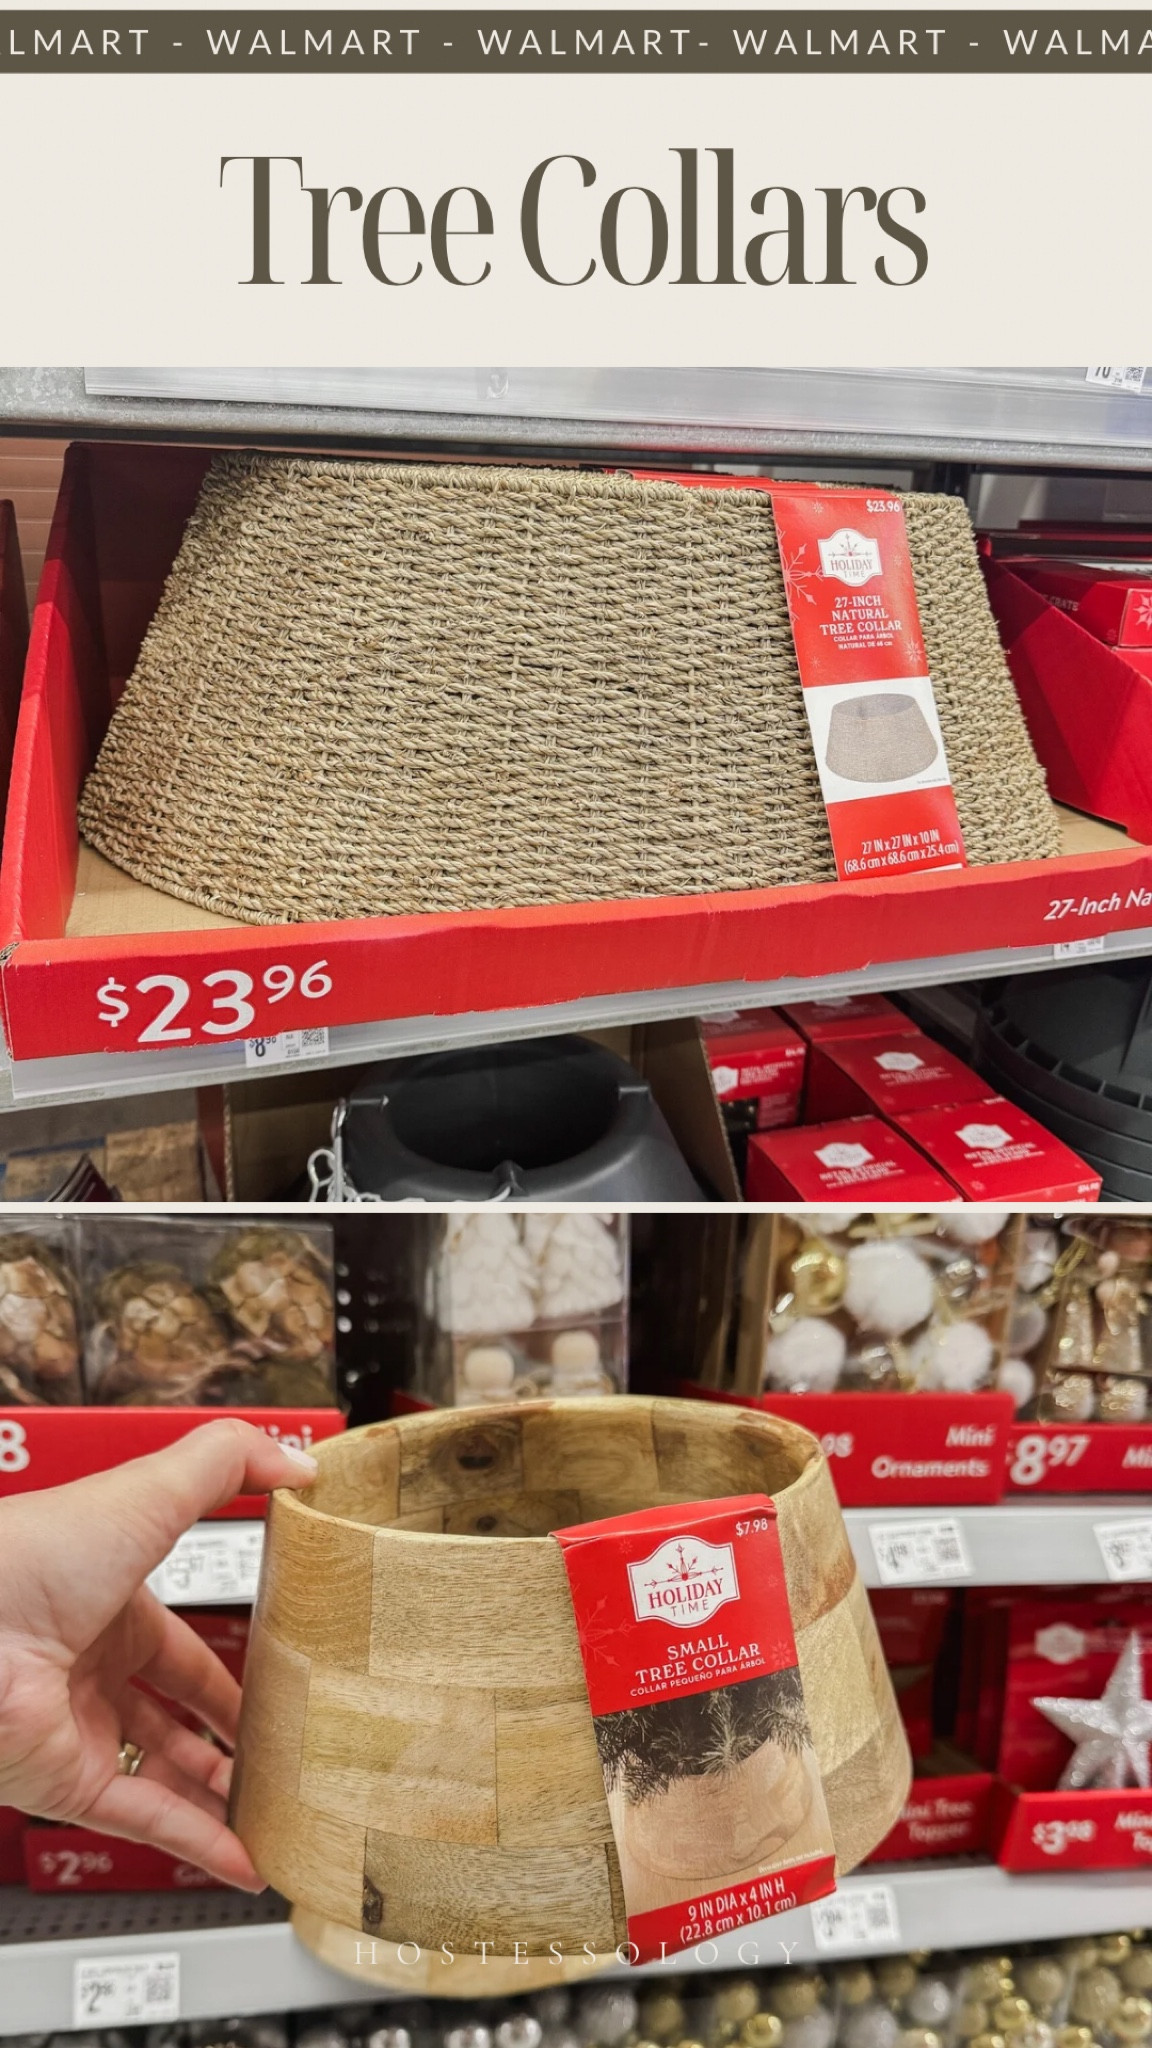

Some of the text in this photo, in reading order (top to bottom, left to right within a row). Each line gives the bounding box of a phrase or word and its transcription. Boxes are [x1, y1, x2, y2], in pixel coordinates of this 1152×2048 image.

[866, 499, 900, 512] $23.96
[830, 559, 873, 571] HOLIDAY
[844, 570, 865, 578] TIME
[834, 595, 881, 608] 27-INCH
[832, 607, 889, 621] NATURAL
[819, 620, 902, 636] TREE COLLAR
[861, 829, 940, 855] 27 IN x 27 IN x 10 IN
[844, 840, 959, 875] (68.6 cm x 68.6 cm x 25.4 cm)
[1043, 888, 1152, 920] 27-Inch Na
[945, 1424, 996, 1447] Mini
[871, 1455, 990, 1479] Ornaments
[735, 1518, 768, 1537] $7.98
[648, 1578, 724, 1609] HOLIDAY
[671, 1599, 709, 1617] TIME
[667, 1634, 729, 1660] SMALL
[635, 1643, 761, 1684] TREE COLLAR
[630, 1657, 765, 1697] COLLAR PEQUEÑO PARA ÁRBOL
[688, 1877, 785, 1922] 9 IN DIA x 4 IN H
[680, 1892, 797, 1944] (22.8 cm x 10.1 cm)
